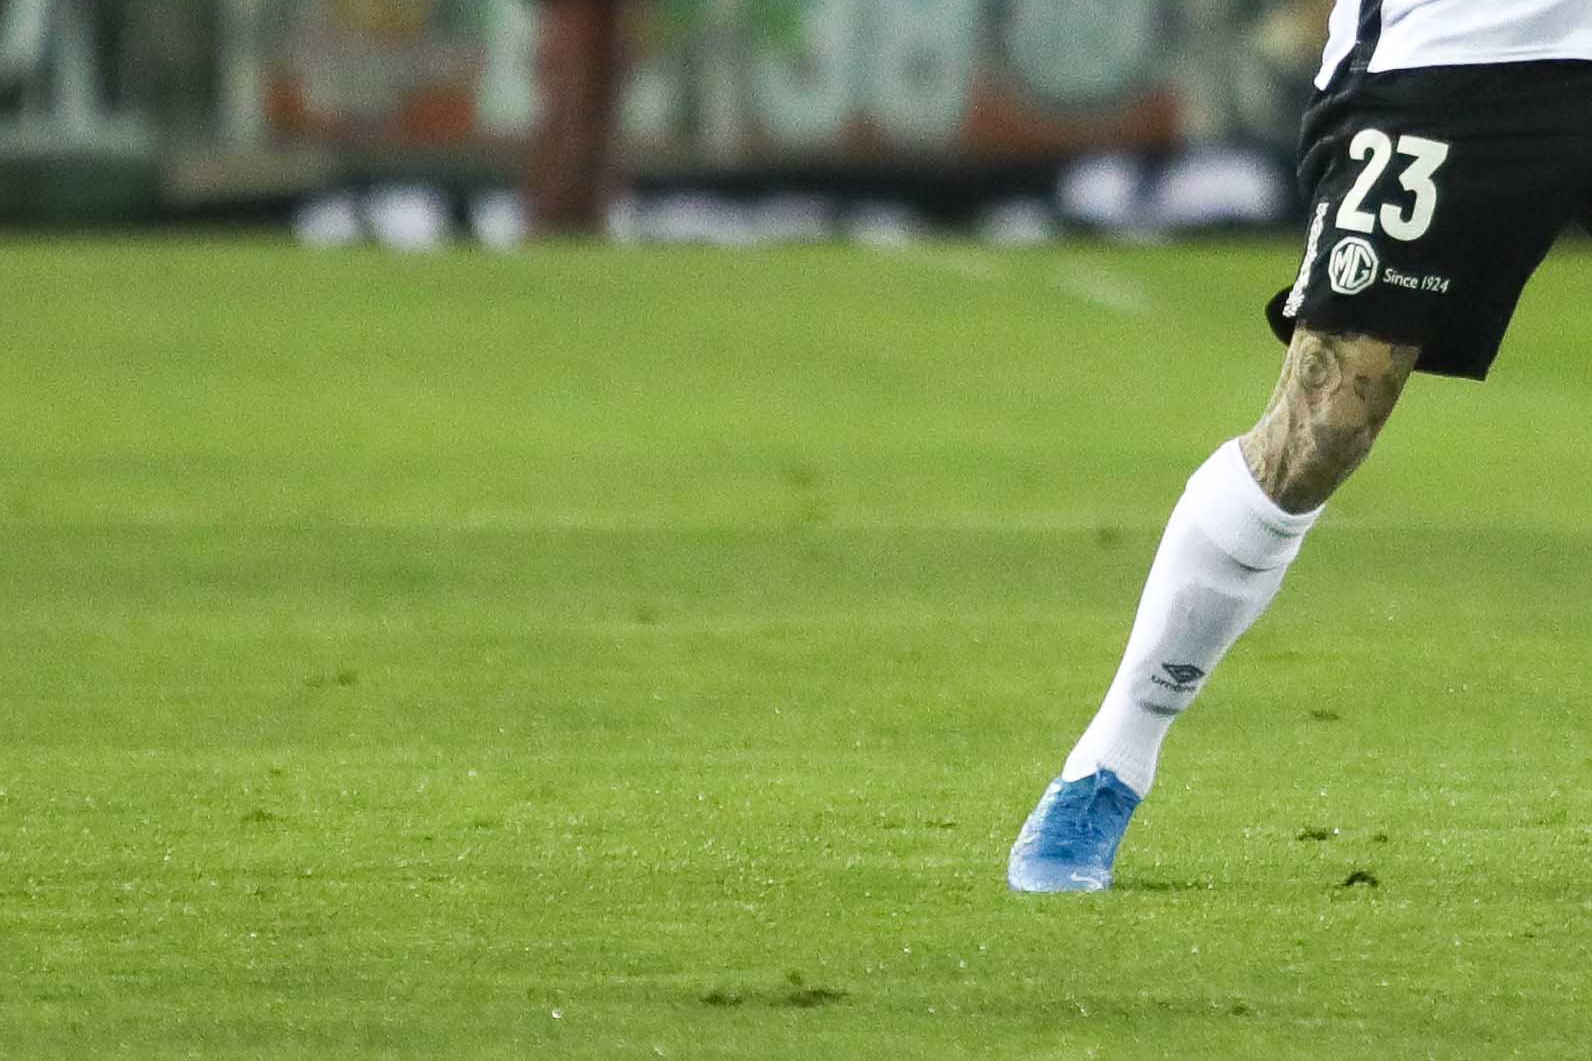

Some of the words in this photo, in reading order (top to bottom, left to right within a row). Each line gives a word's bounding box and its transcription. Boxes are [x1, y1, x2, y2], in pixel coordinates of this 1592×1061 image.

[1335, 128, 1449, 241] 23
[1333, 242, 1374, 290] MG
[1383, 268, 1418, 289] Since
[1421, 275, 1450, 293] 1924
